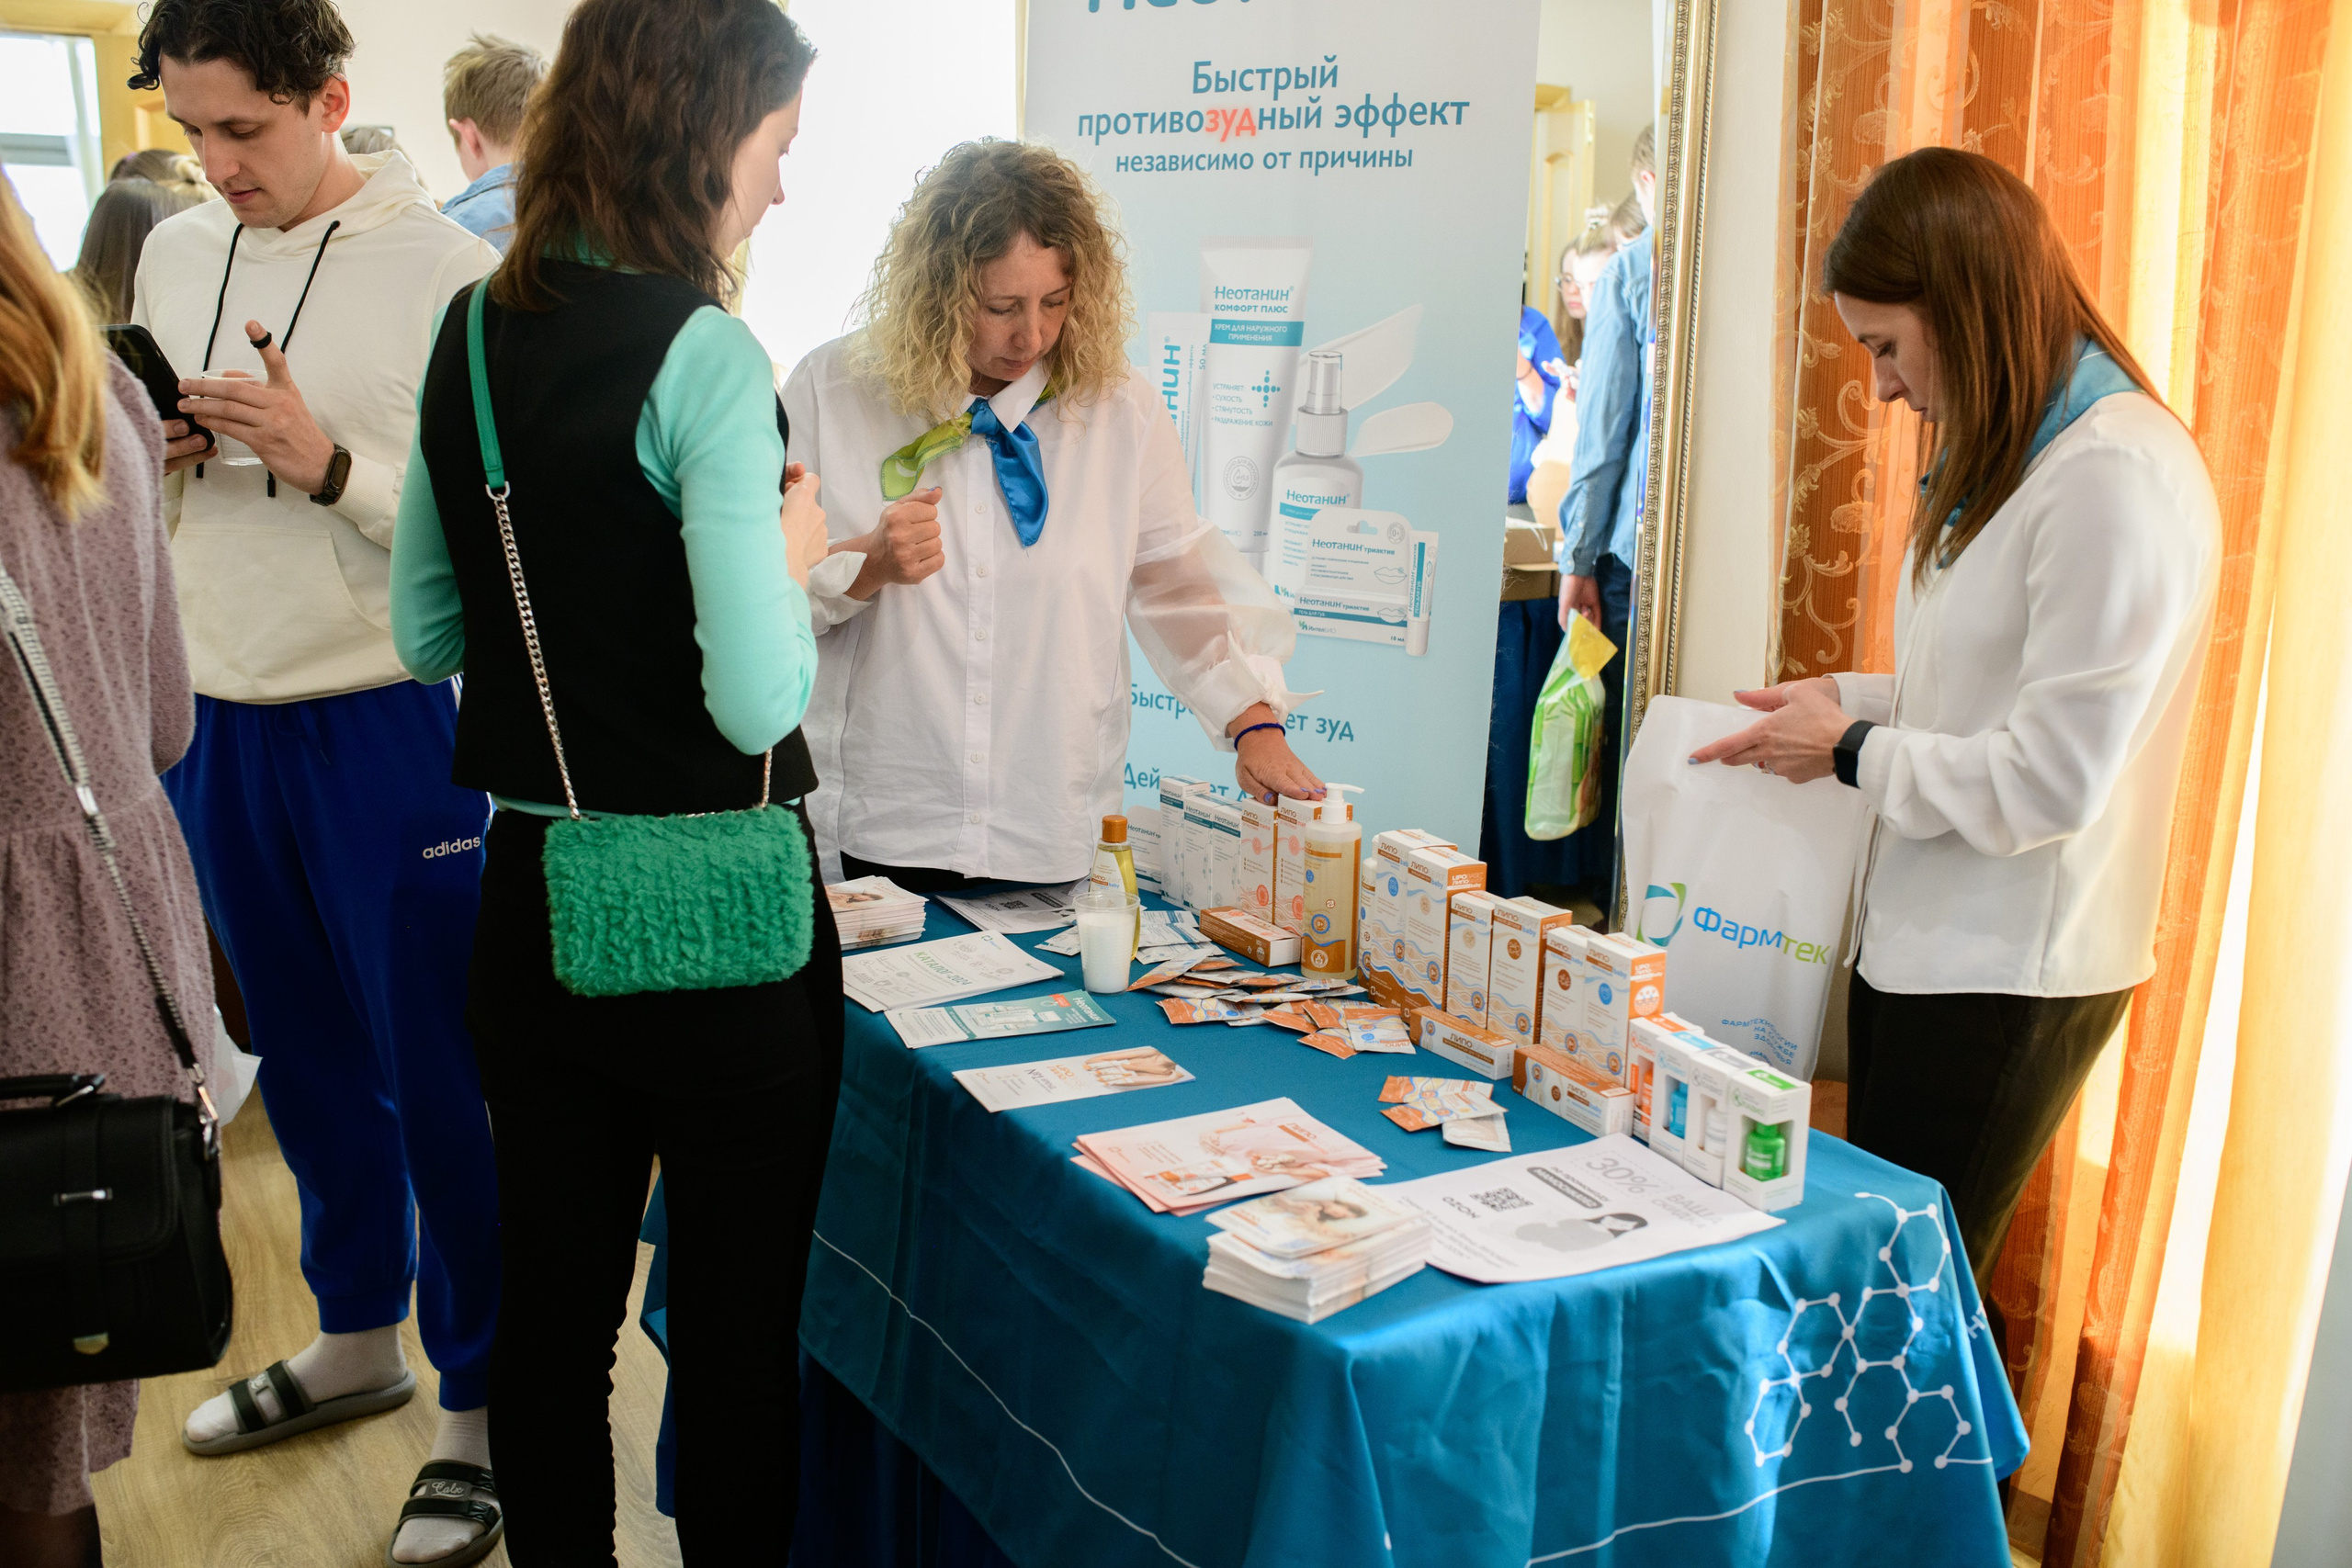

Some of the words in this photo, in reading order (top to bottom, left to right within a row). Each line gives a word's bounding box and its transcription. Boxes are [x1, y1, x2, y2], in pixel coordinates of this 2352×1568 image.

[1192, 54, 1339, 100] Быстрый
[1078, 96, 1323, 145] противозудный
[1334, 93, 1470, 140] эффект
[1115, 149, 1254, 173] независимо
[1262, 148, 1291, 170] от
[1299, 147, 1414, 176] причины
[1214, 304, 1259, 313] КОМФОРТ
[1261, 305, 1288, 313] ПЛЮС
[1214, 323, 1230, 332] КРЕМ
[1231, 324, 1245, 333] ДЛЯ
[1246, 324, 1288, 334] НАРУЖНОГО
[1227, 333, 1272, 342] ПРИМЕНЕНИЯ
[1214, 405, 1253, 415] СТЯНУТОСТЬ
[1215, 394, 1242, 403] СУХОСТЬ
[1316, 717, 1354, 742] зуд
[422, 836, 481, 860] adidas
[1692, 905, 1832, 965] Фармтек
[1586, 1156, 1659, 1194] 30%
[1667, 1193, 1724, 1225] ВАША
